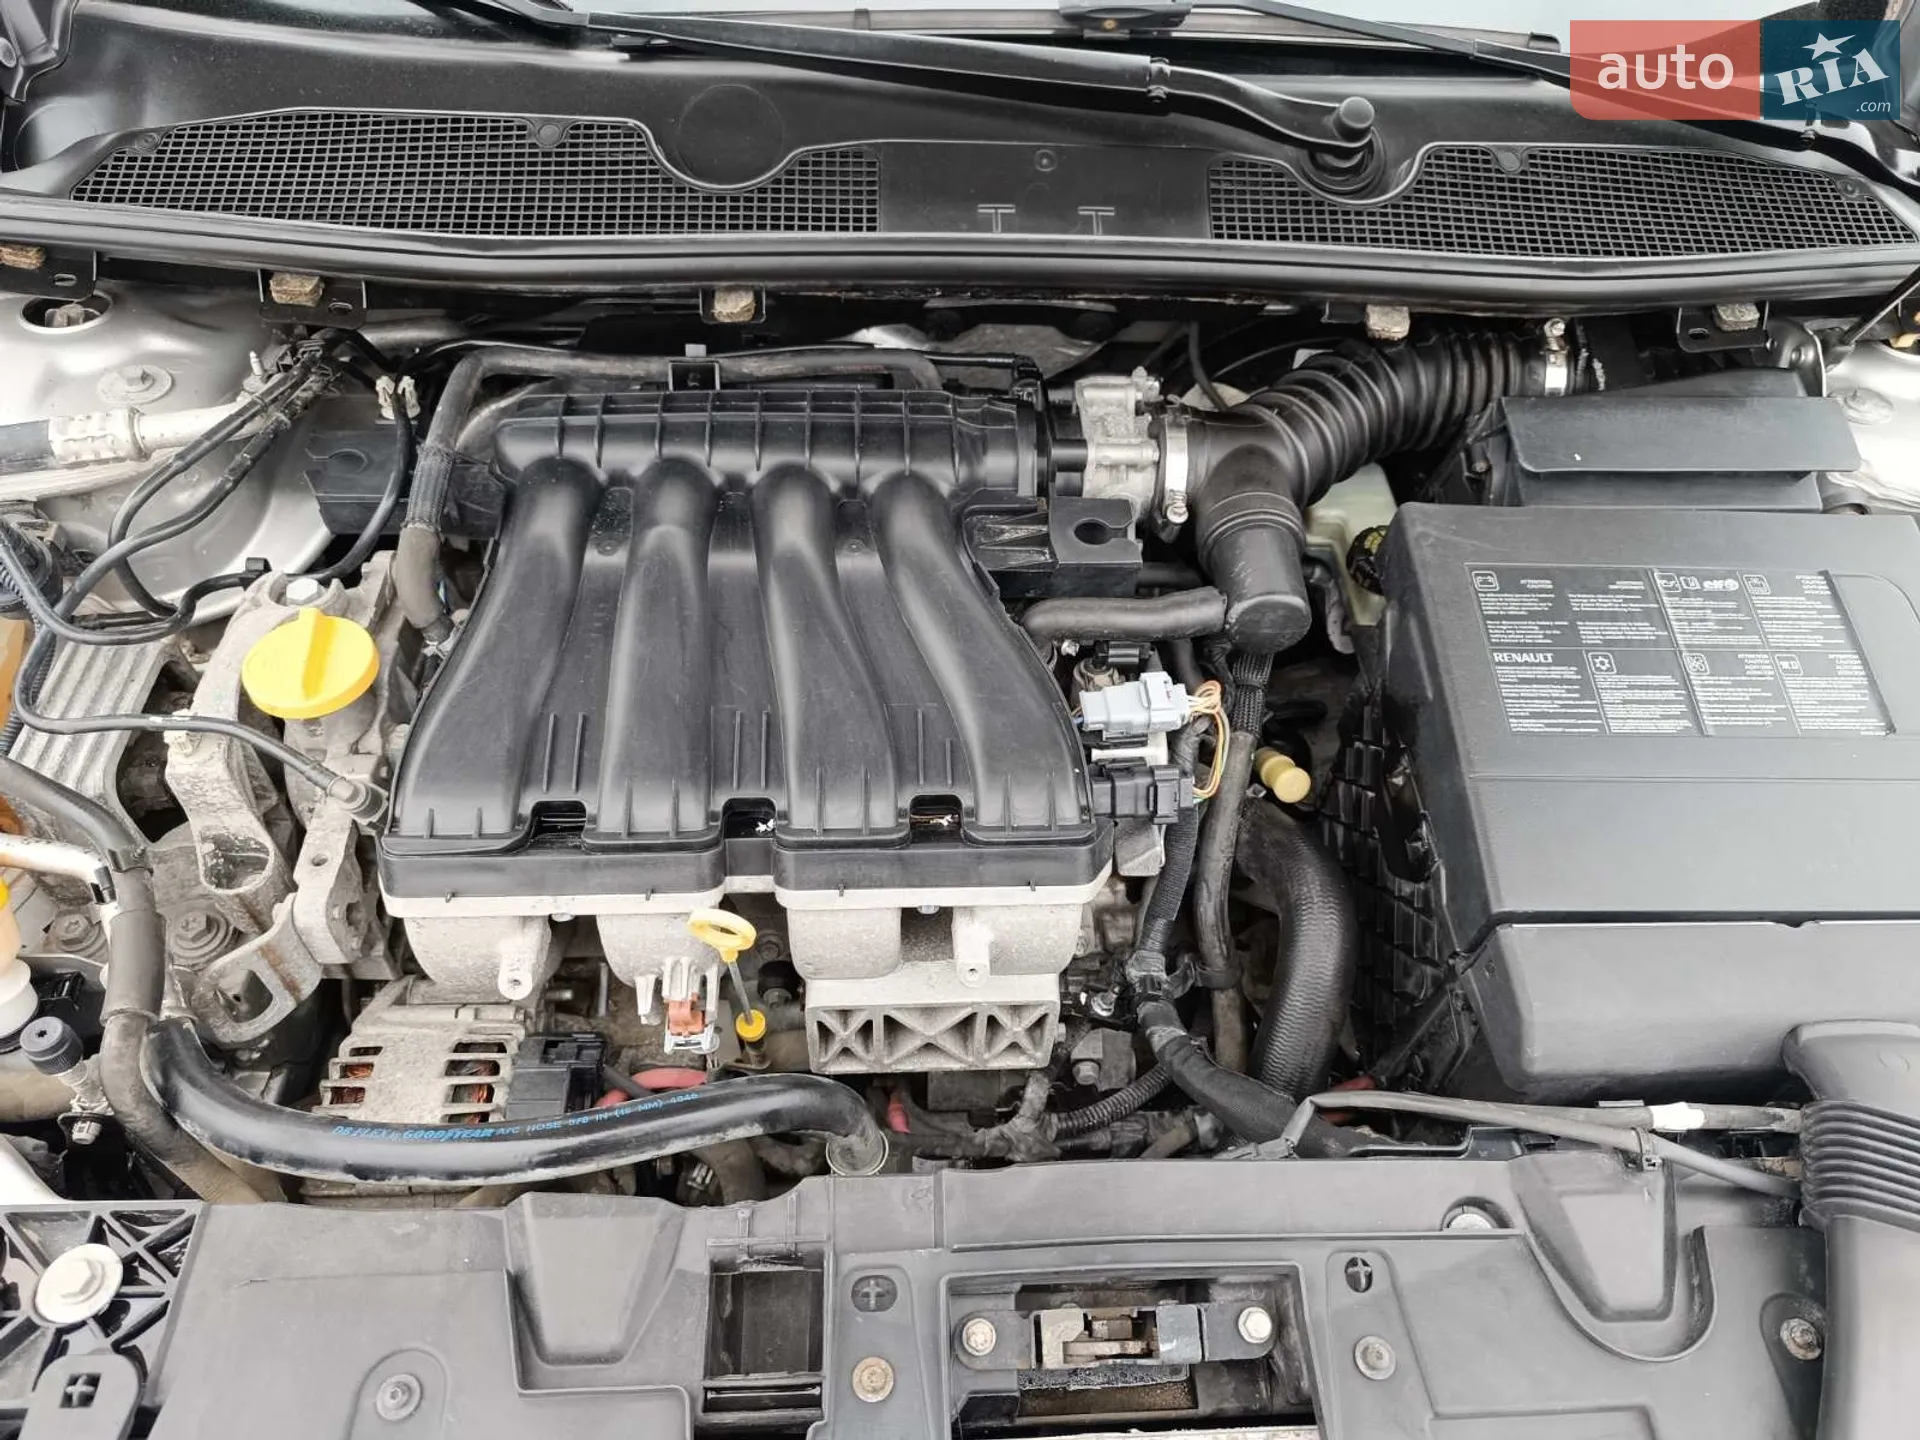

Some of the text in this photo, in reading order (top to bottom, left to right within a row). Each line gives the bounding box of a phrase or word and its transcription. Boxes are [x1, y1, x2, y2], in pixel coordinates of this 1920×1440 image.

[1493, 652, 1553, 663] RENAULT
[402, 1127, 496, 1142] GOODYEAR
[526, 1121, 562, 1132] HOSE
